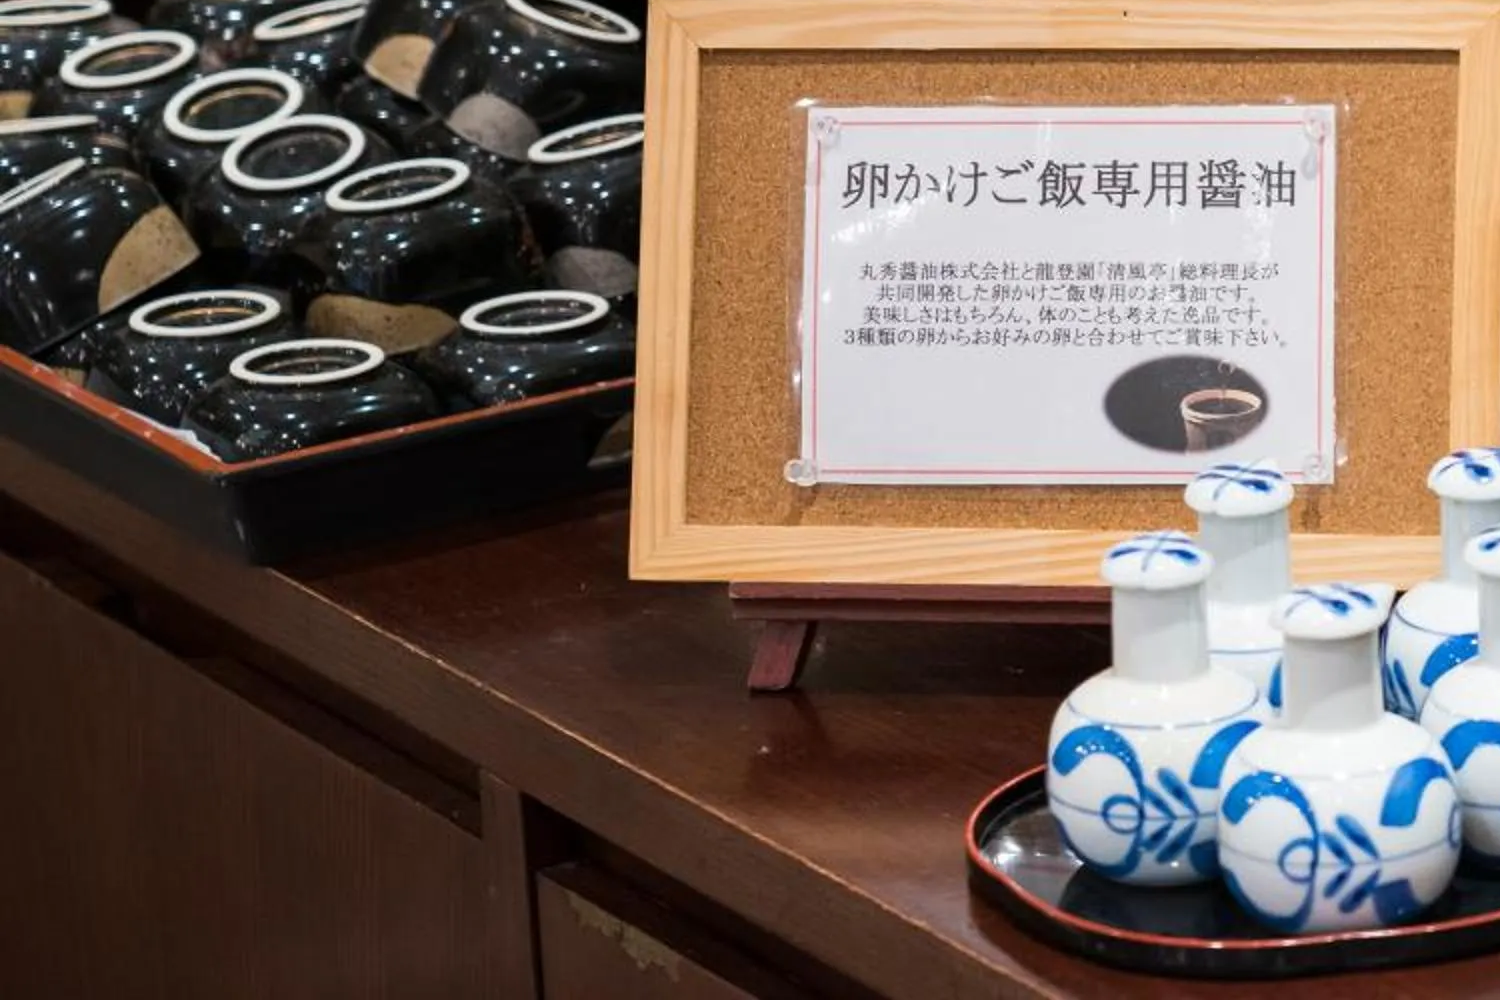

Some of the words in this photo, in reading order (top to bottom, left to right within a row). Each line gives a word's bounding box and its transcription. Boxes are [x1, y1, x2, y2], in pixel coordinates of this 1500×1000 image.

[842, 158, 1297, 209] 卵かけご飯専用醤油
